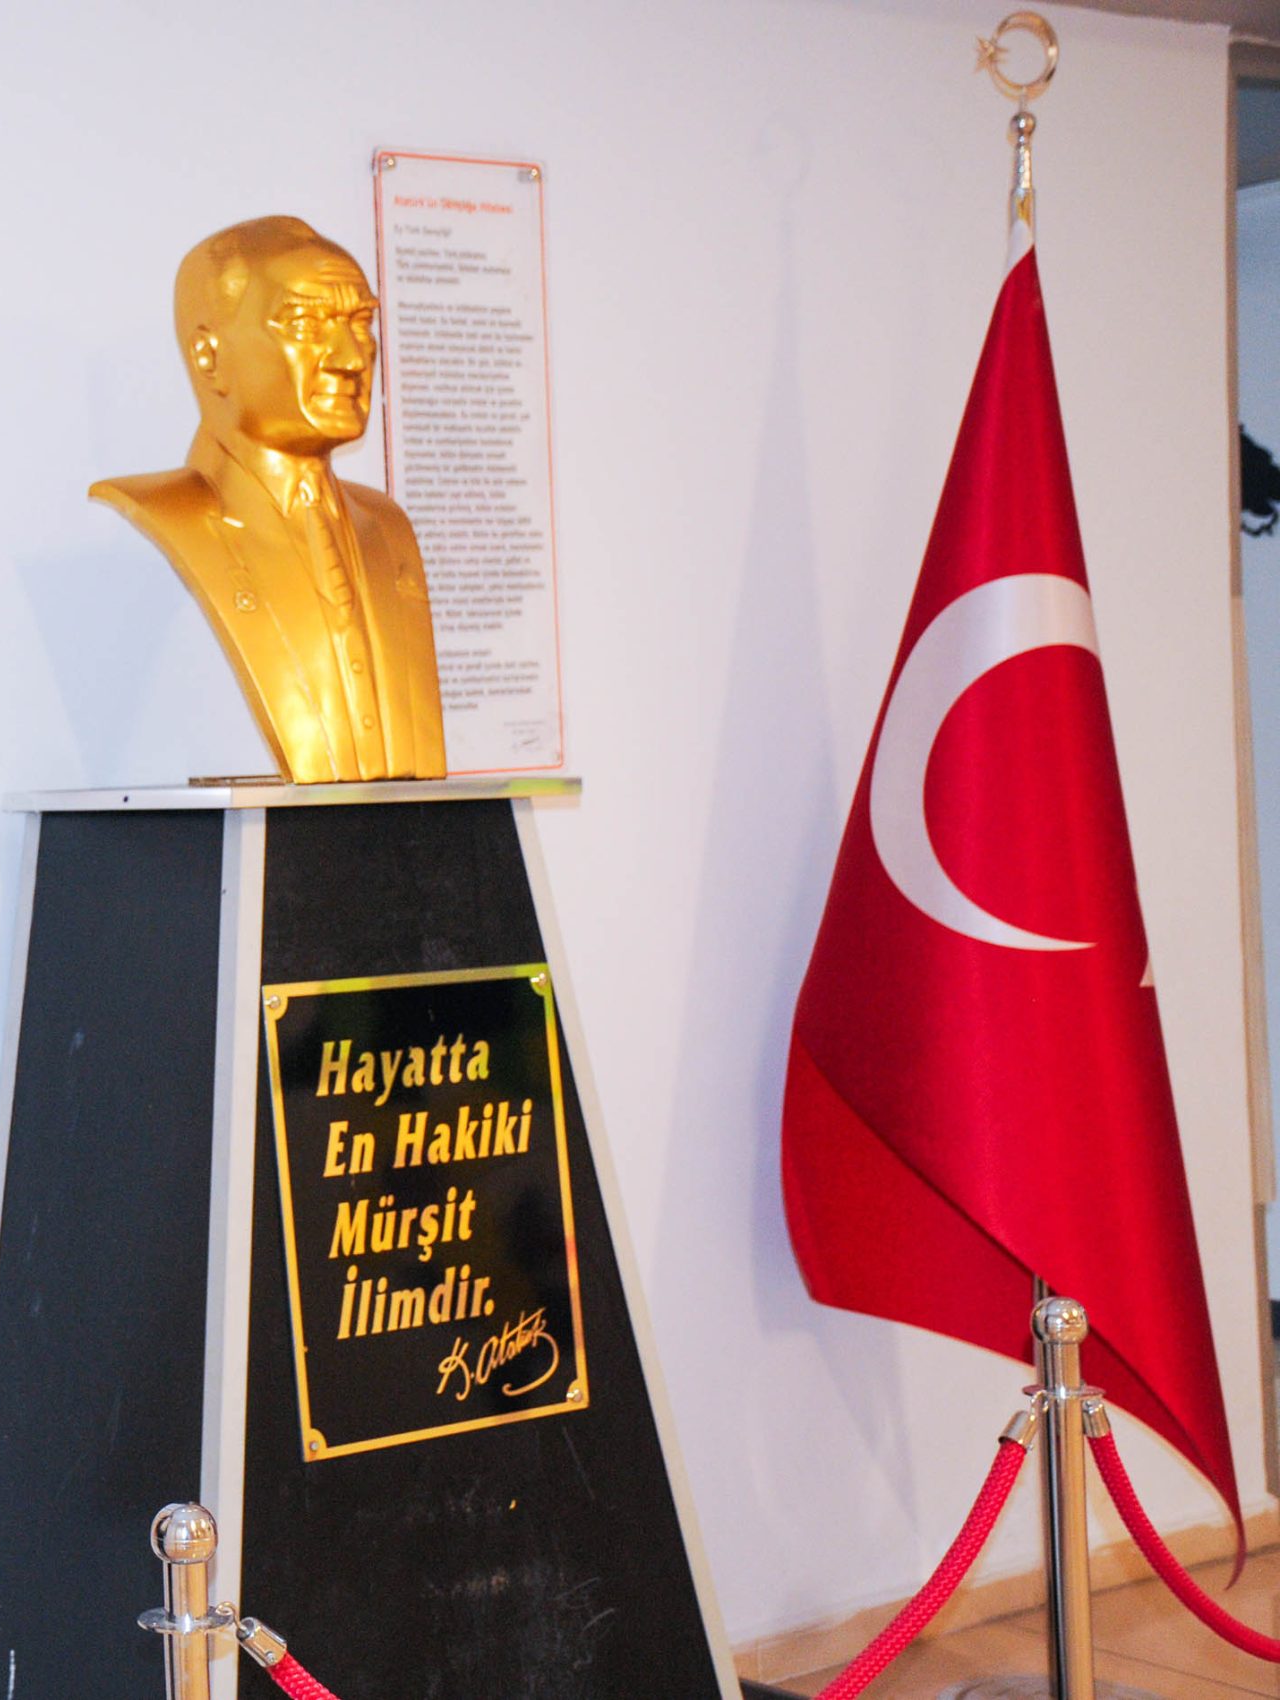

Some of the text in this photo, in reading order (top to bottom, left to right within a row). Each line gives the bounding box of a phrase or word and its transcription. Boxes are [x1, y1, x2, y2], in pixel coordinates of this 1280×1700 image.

[316, 1034, 489, 1106] Hayatta
[323, 1099, 532, 1178] En Hakiki
[328, 1186, 475, 1261] Mürşit
[337, 1264, 495, 1340] İlimdir.
[436, 1336, 475, 1401] K.
